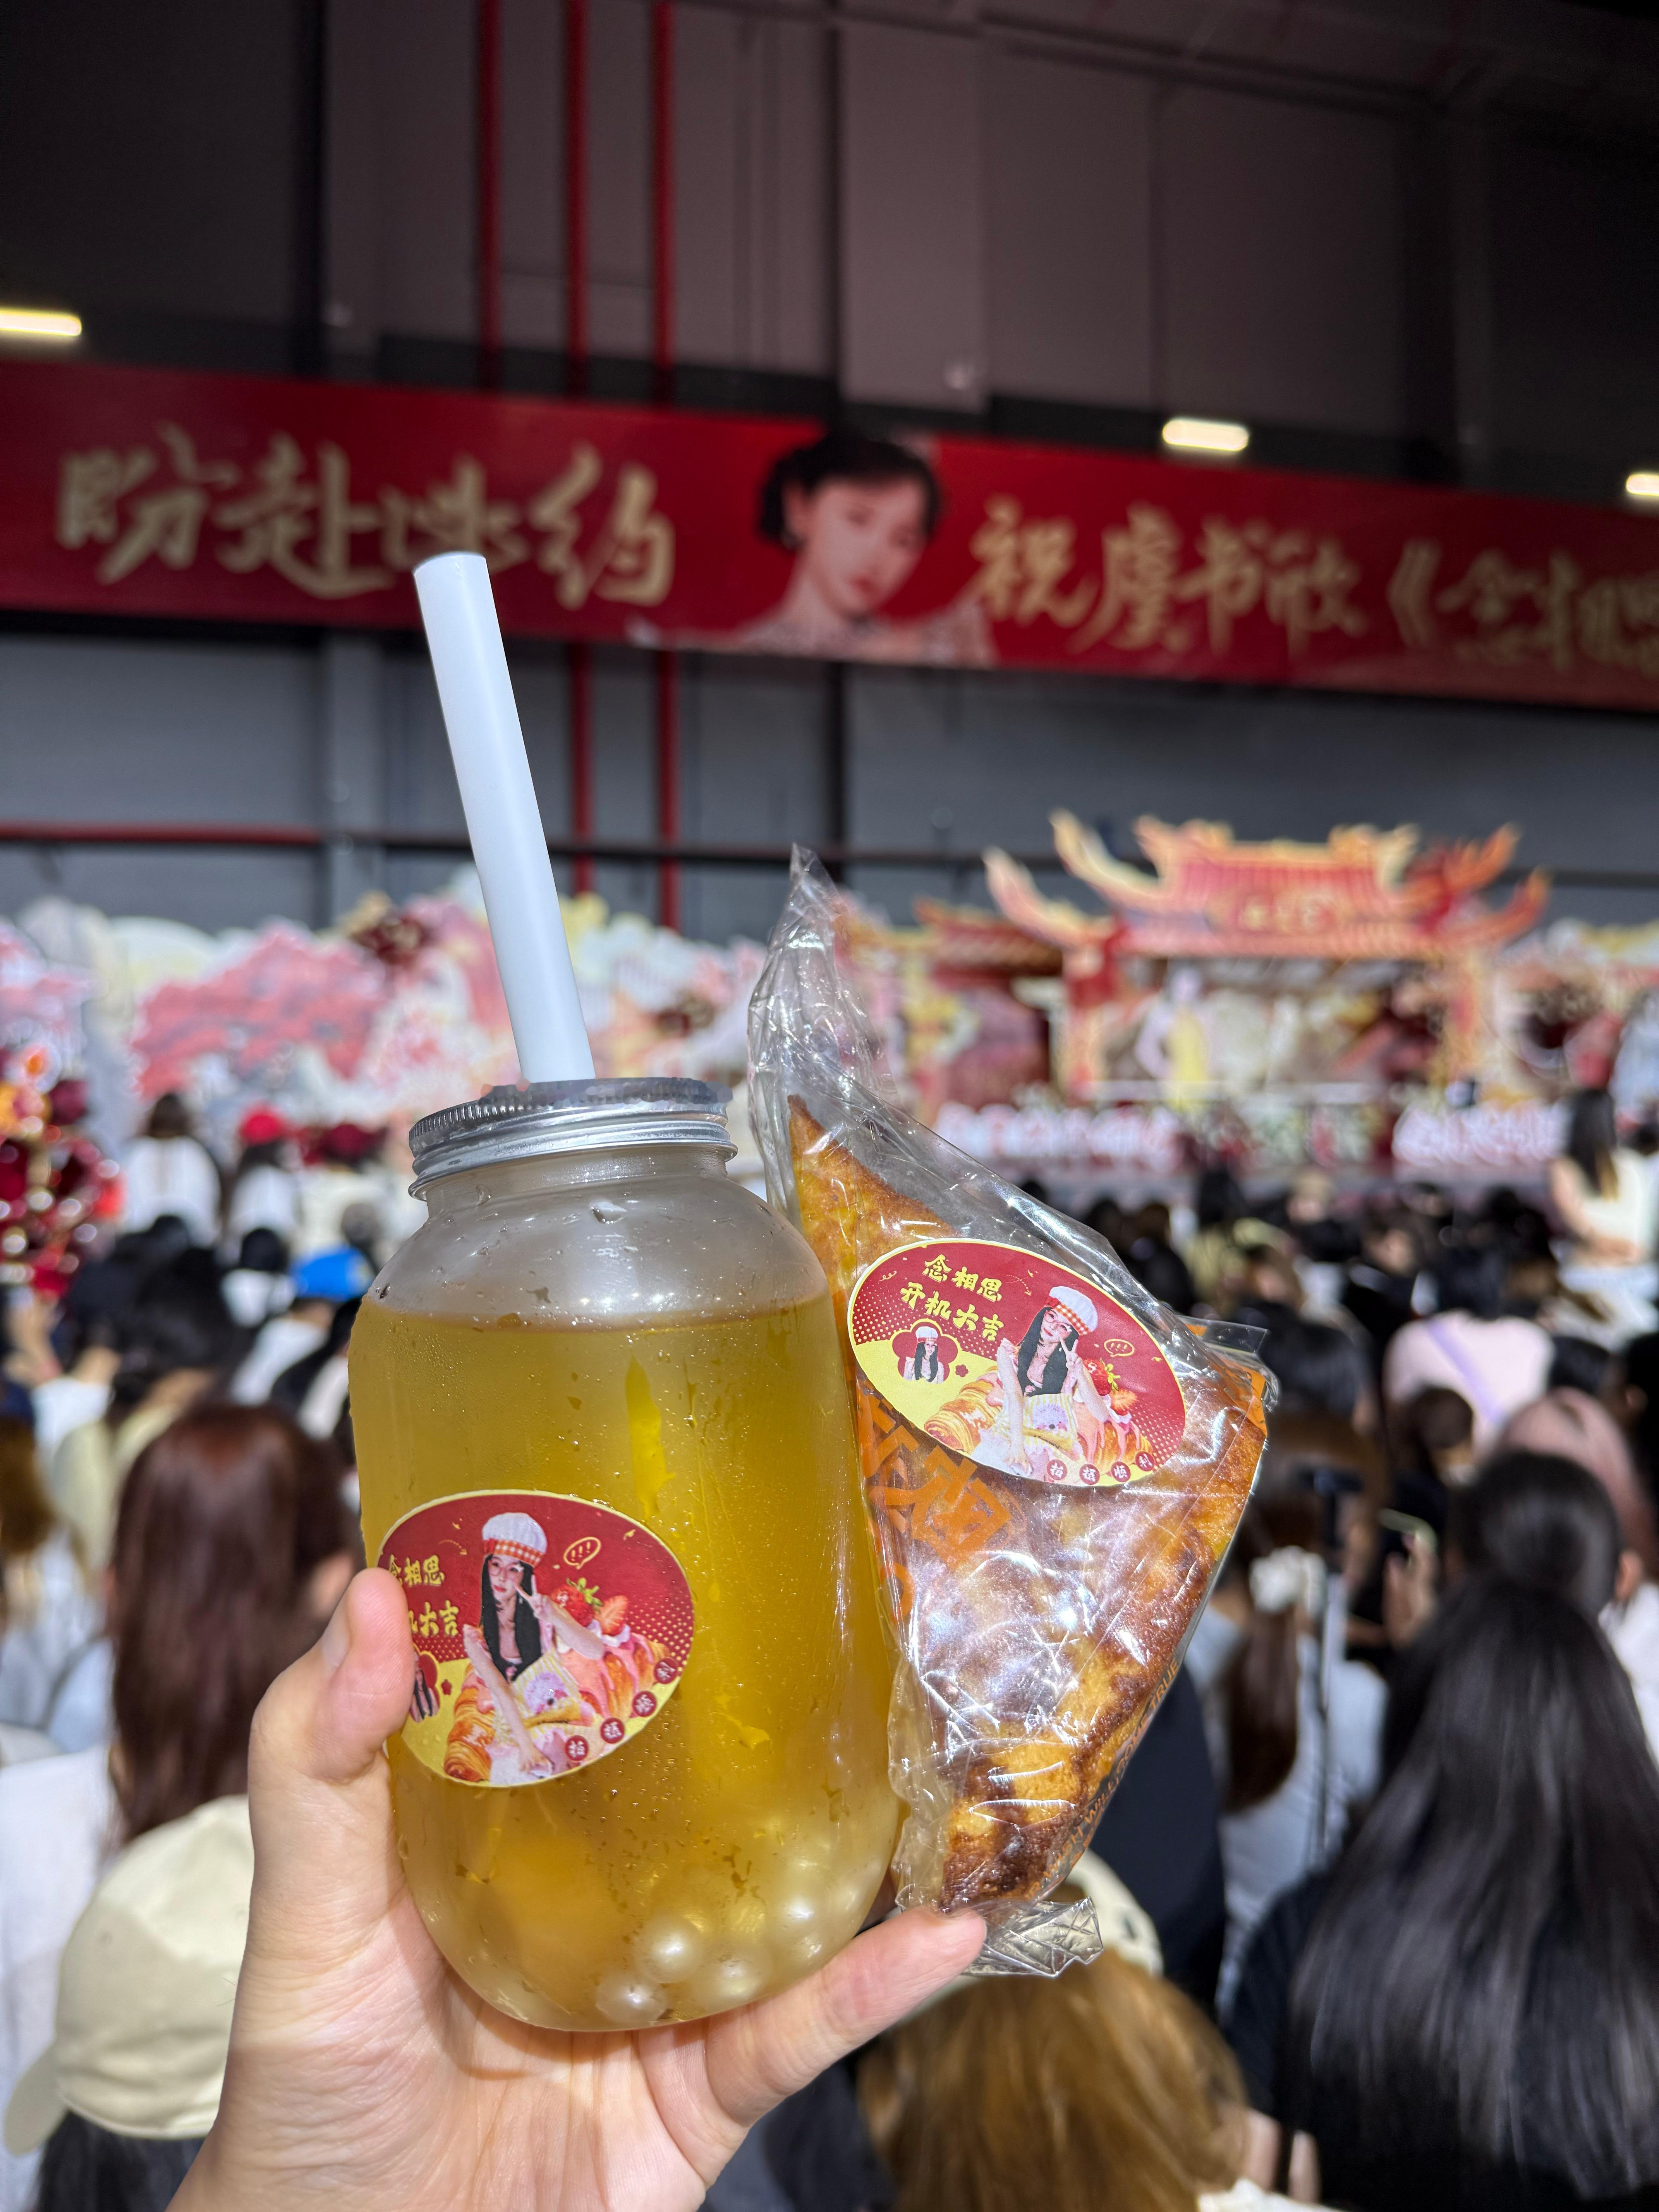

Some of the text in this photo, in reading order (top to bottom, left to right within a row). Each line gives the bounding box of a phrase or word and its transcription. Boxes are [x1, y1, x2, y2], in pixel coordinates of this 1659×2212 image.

[922, 1254, 1002, 1302] 念相思
[900, 1281, 1004, 1342] 开机大吉
[1149, 1657, 1180, 1711] TRUE
